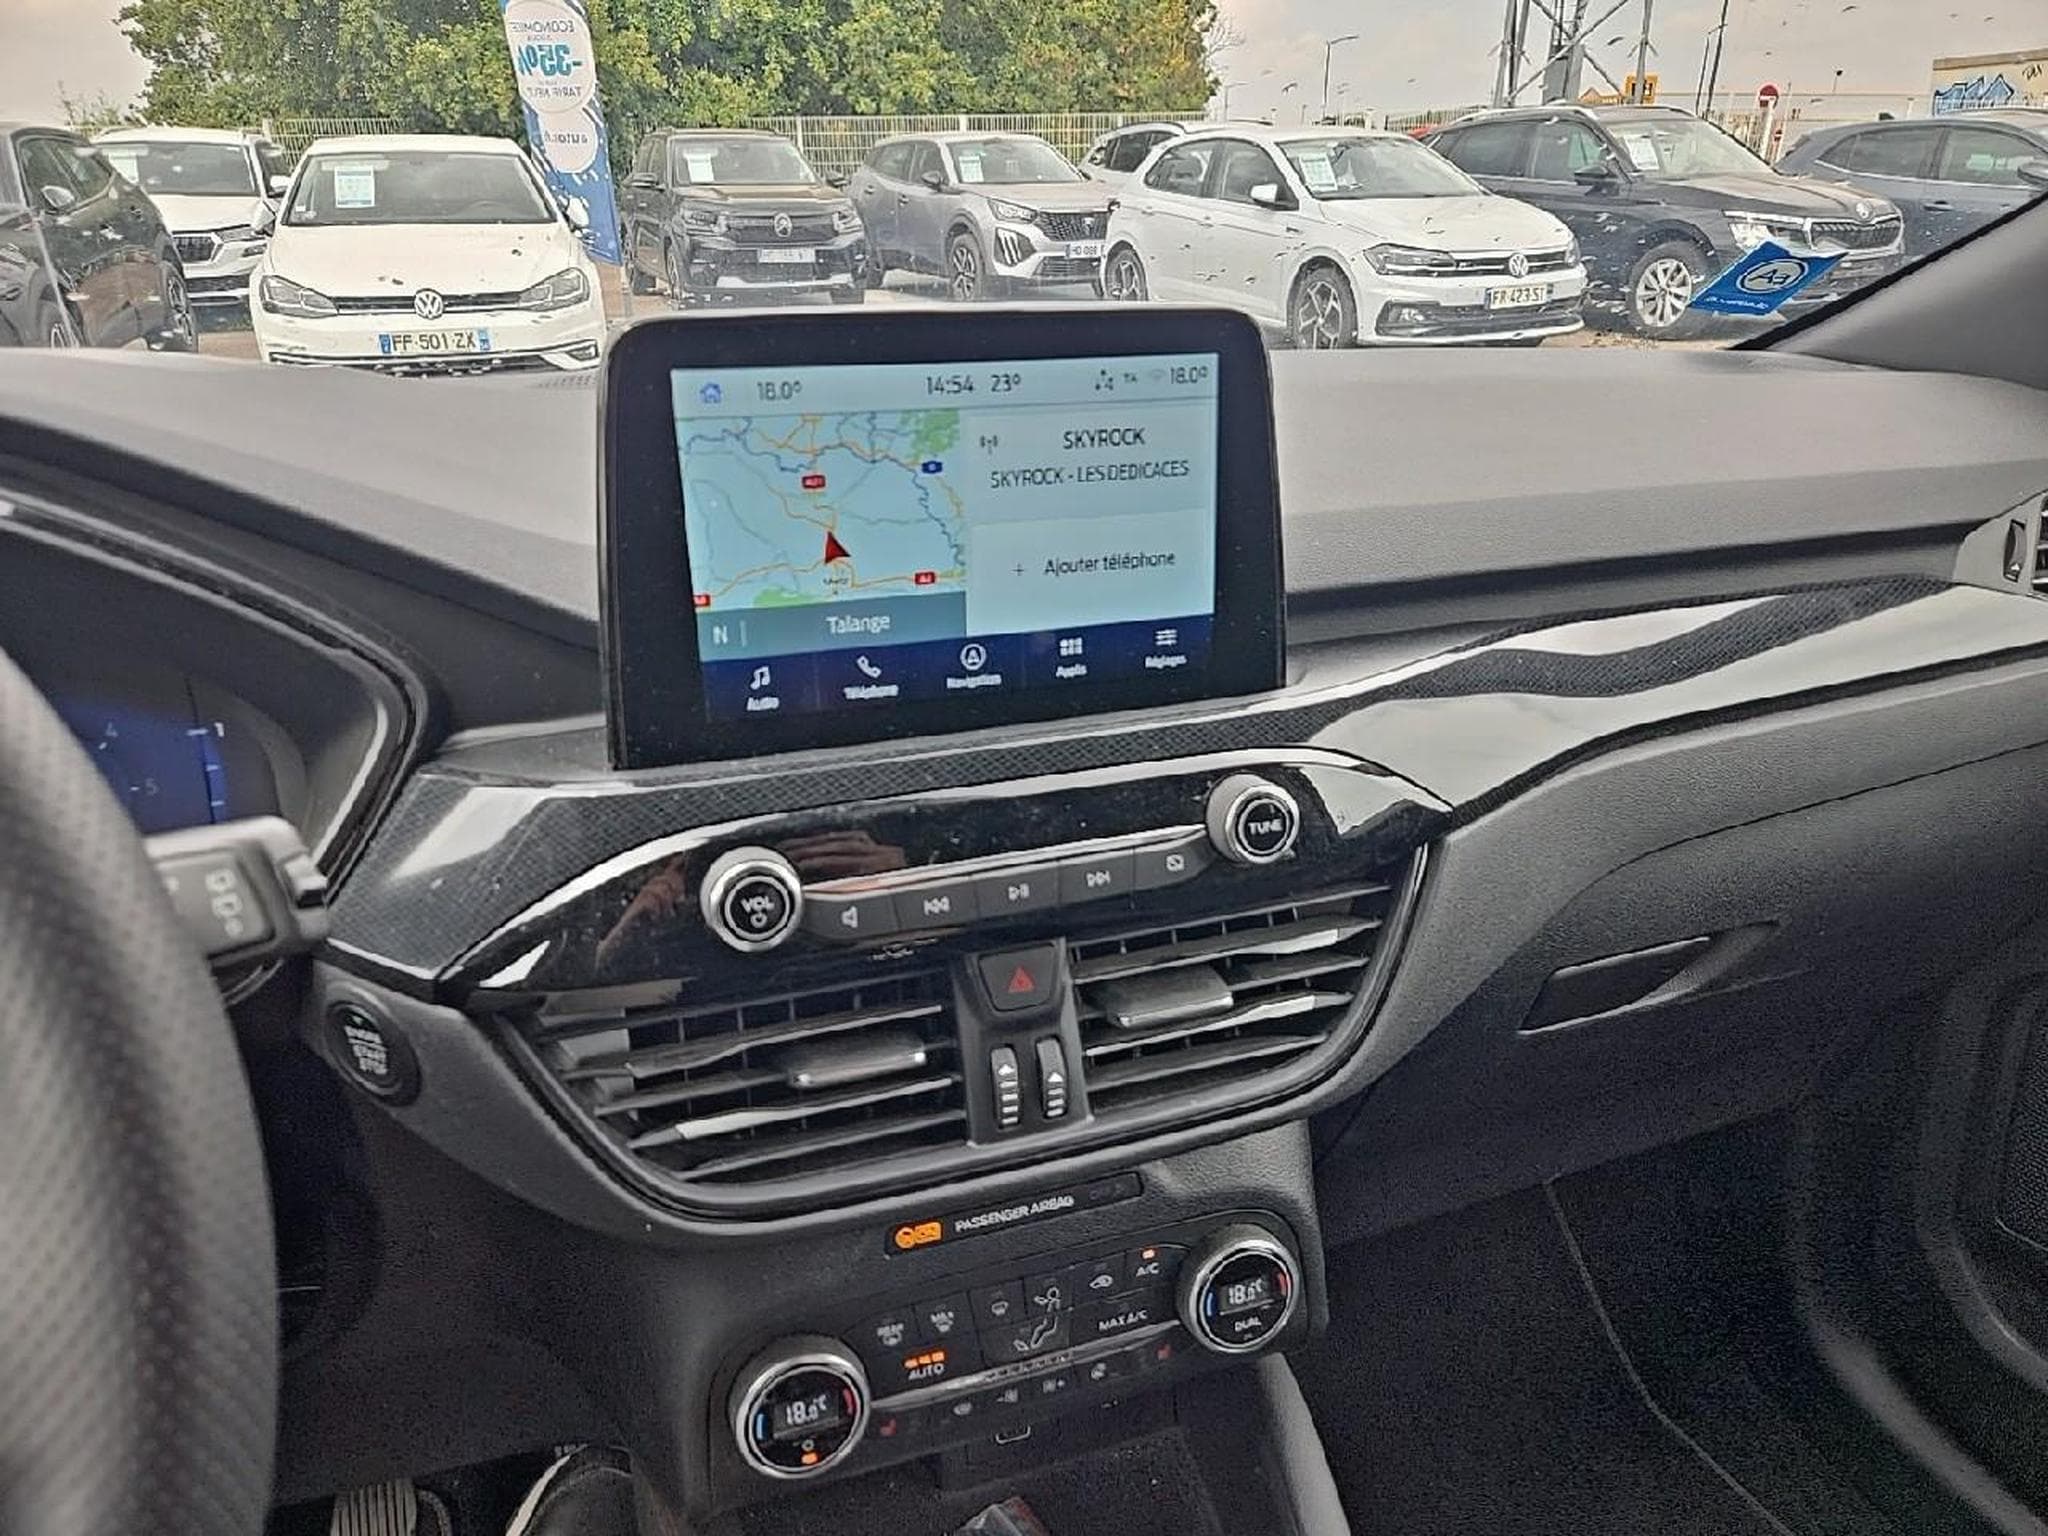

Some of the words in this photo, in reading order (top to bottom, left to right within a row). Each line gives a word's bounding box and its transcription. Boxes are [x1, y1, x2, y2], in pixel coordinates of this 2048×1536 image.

[926, 375, 974, 395] 14:54
[1062, 427, 1146, 450] SKYROCK
[990, 466, 1064, 489] SKYROCK
[1106, 459, 1190, 482] DEDICACES
[1043, 558, 1099, 577] Ajouter
[1102, 551, 1176, 575] téléphone
[825, 614, 891, 635] Talange
[712, 625, 728, 645] N
[1247, 818, 1282, 836] TUNE
[740, 895, 776, 914] VOL
[954, 1205, 1030, 1233] PASSENGER
[1029, 1194, 1075, 1215] AIRBAG
[1136, 1261, 1160, 1278] A/C
[1098, 1316, 1125, 1332] MAX
[1234, 1315, 1263, 1333] DUAL
[908, 1363, 945, 1381] AUTO
